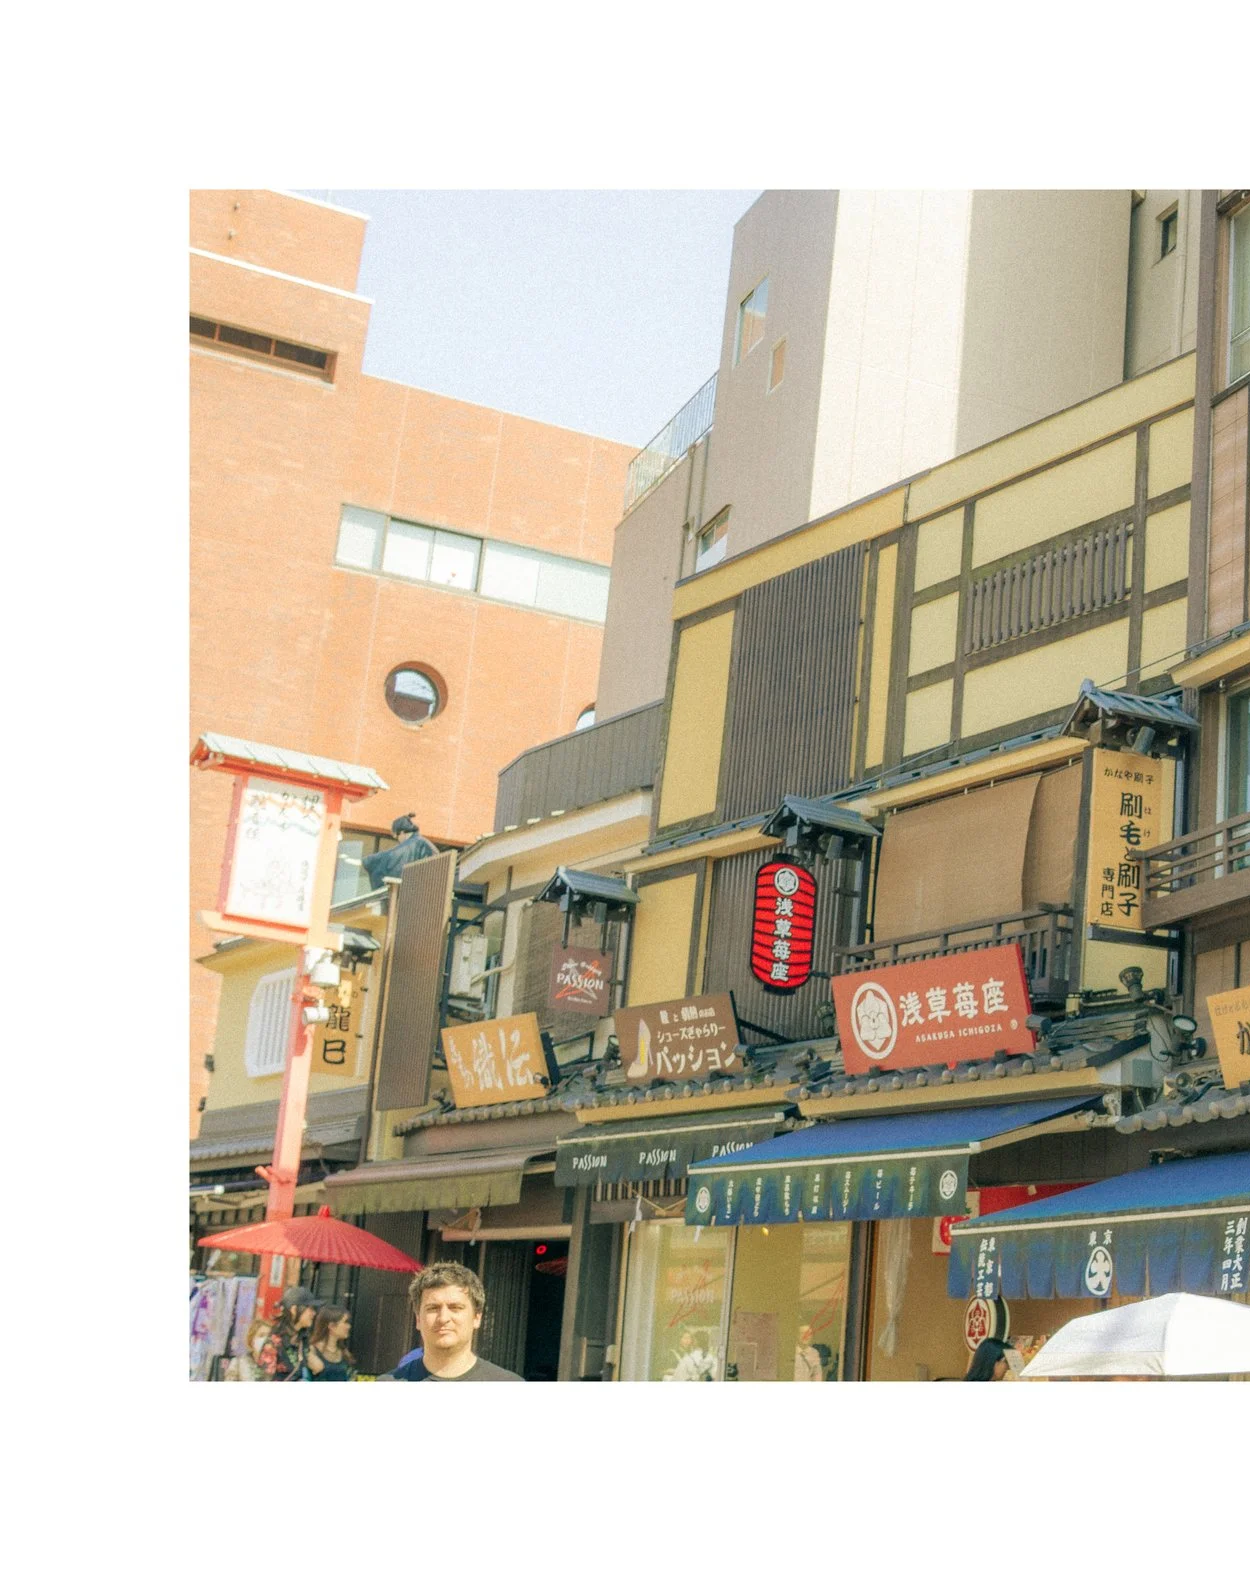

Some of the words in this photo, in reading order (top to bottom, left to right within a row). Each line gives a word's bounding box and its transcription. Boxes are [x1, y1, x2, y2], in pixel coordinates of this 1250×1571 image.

[1103, 767, 1155, 785] かなや刷子
[1116, 791, 1143, 917] 刷毛と刷子
[1100, 867, 1115, 917] 専門店
[769, 897, 794, 982] 浅草苺座
[556, 972, 604, 990] PASSION
[899, 977, 1009, 1027] 浅草苺座
[915, 1029, 956, 1043] ASAKUSA
[958, 1023, 1003, 1038] ICHIGOZA
[656, 1041, 737, 1075] パッション
[572, 1153, 608, 1171] PASSION
[638, 1148, 677, 1166] PASSION
[1087, 1229, 1113, 1248] 東京
[1220, 1219, 1236, 1292] 三年四月
[1229, 1216, 1249, 1290] 創業大正
